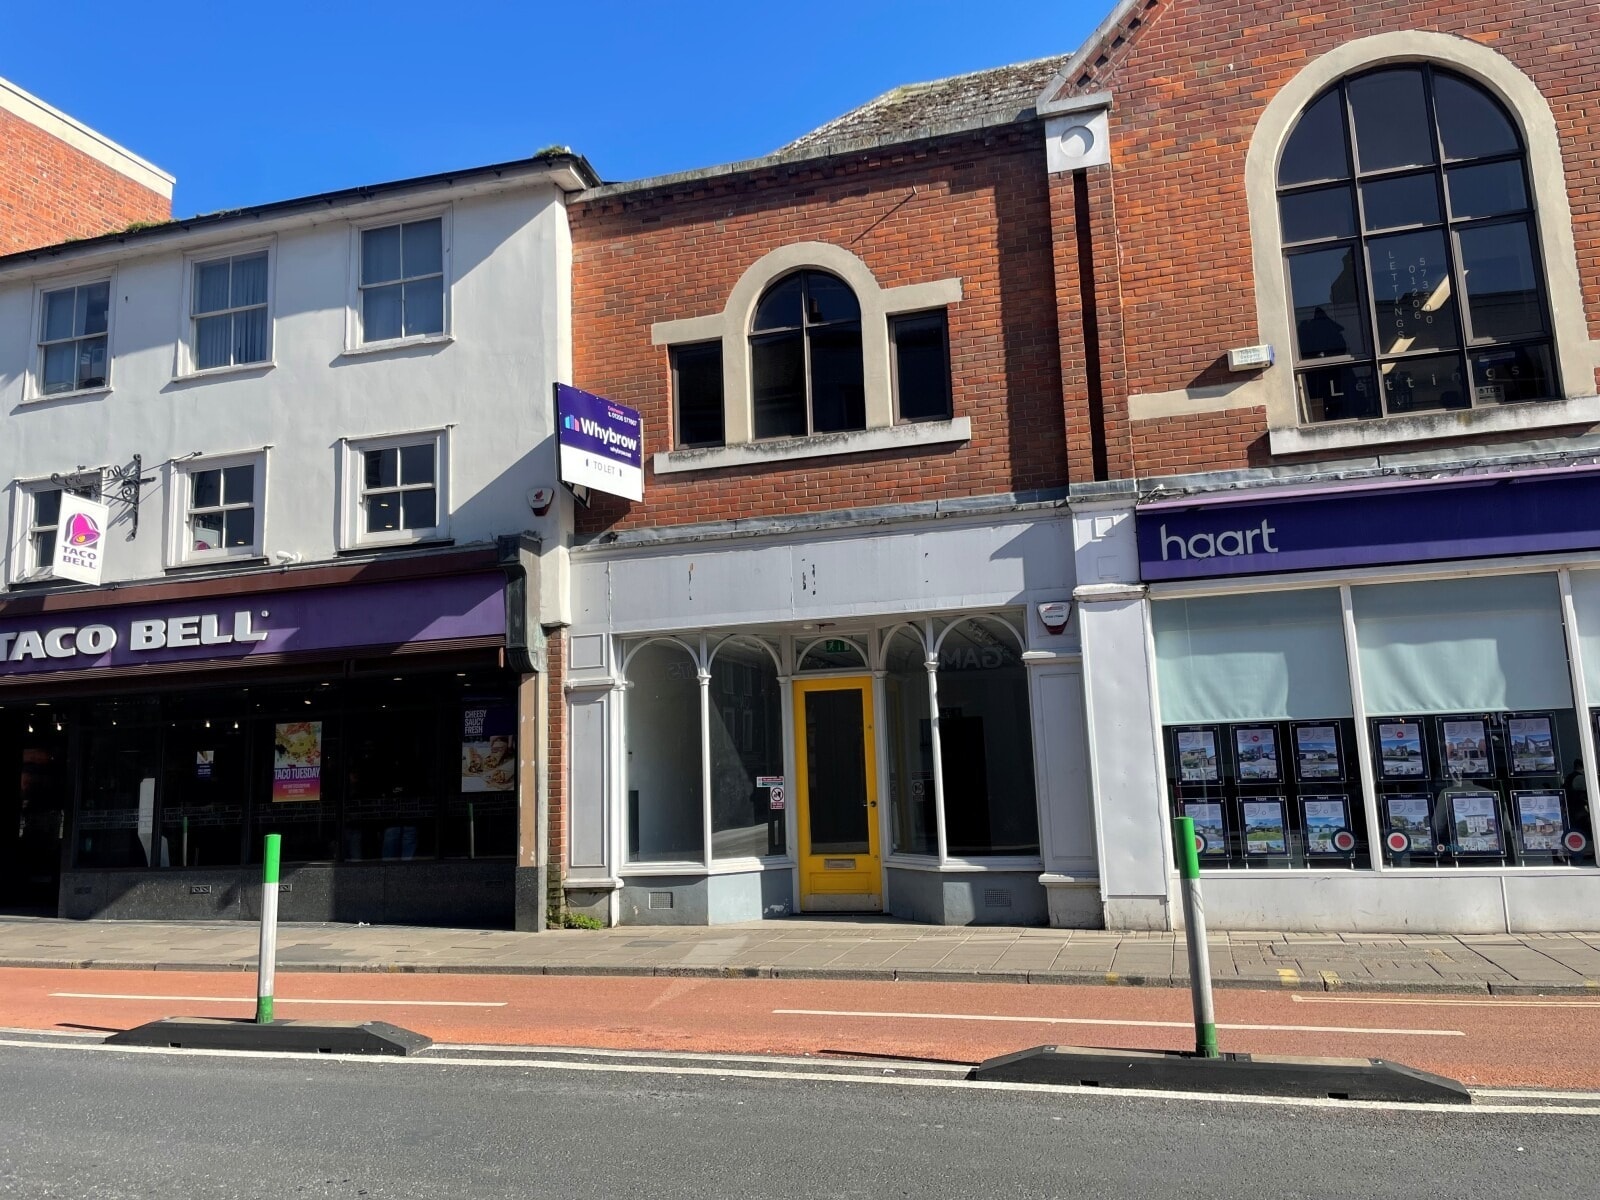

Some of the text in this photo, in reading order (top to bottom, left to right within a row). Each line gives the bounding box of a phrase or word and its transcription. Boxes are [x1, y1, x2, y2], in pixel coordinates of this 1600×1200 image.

[580, 418, 637, 451] Whybrow
[593, 461, 615, 475] TO LET
[1160, 519, 1279, 561] haart
[62, 545, 97, 560] TACO
[62, 555, 97, 570] BELL
[130, 611, 268, 650] BELL
[464, 710, 487, 718] CHEESY
[464, 718, 484, 727] SAUCY
[464, 726, 483, 734] FRESH
[274, 767, 320, 780] TACO TUESDAY
